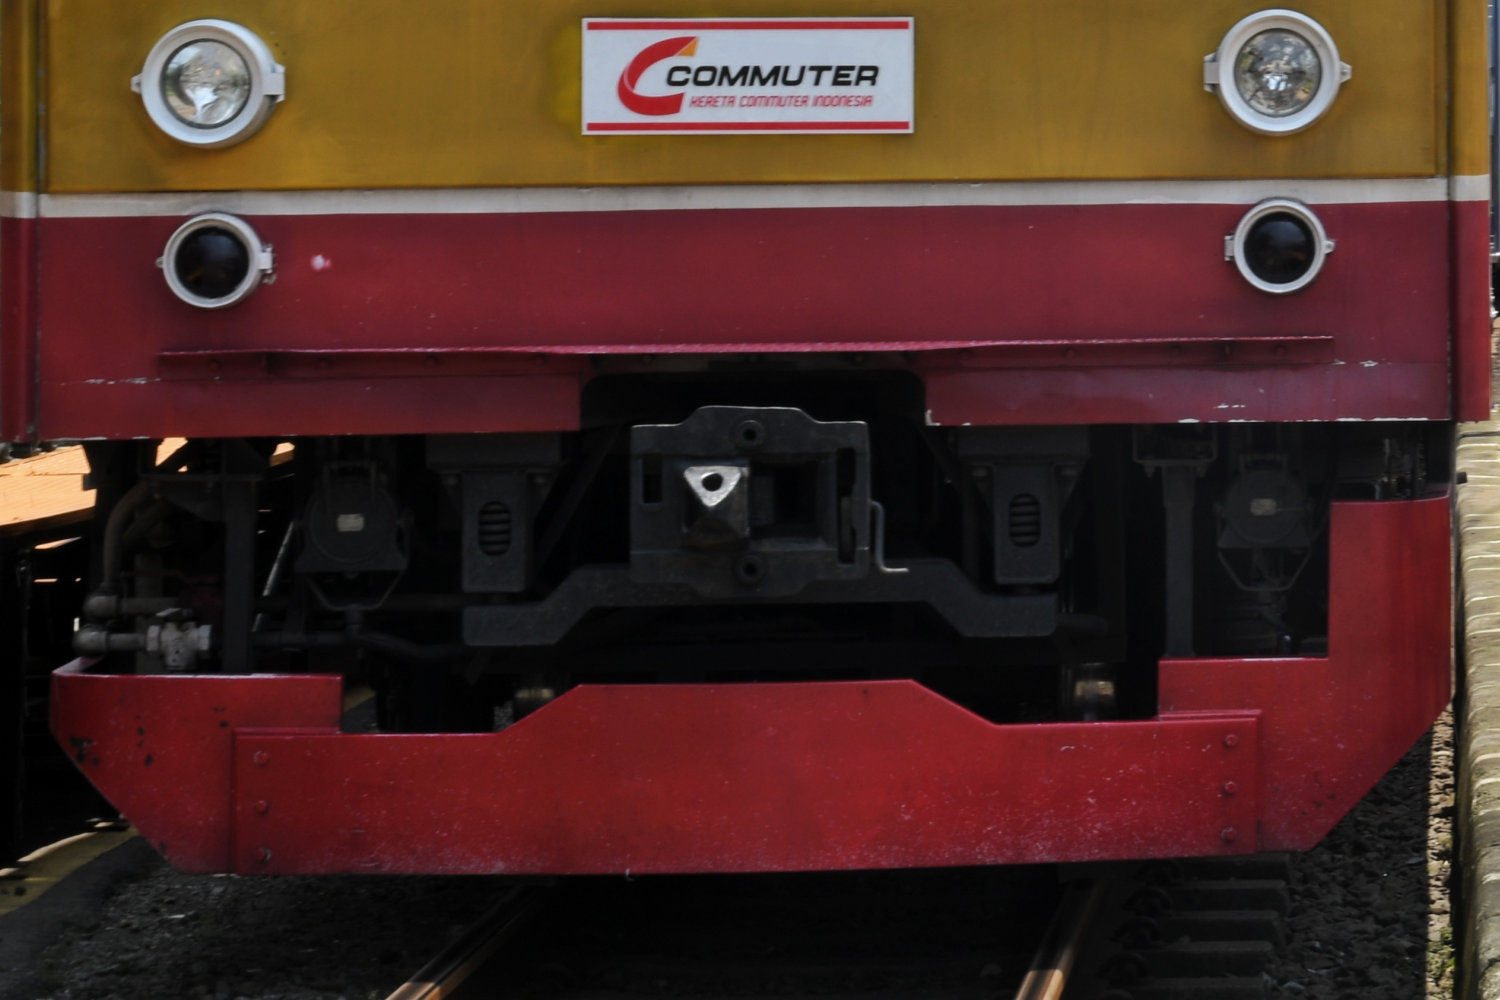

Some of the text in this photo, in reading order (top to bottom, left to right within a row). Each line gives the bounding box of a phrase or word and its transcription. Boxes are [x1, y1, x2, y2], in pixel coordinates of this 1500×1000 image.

[666, 65, 880, 87] COMMUTER
[689, 94, 874, 108] KERETA COMMUTER INDONESIA
